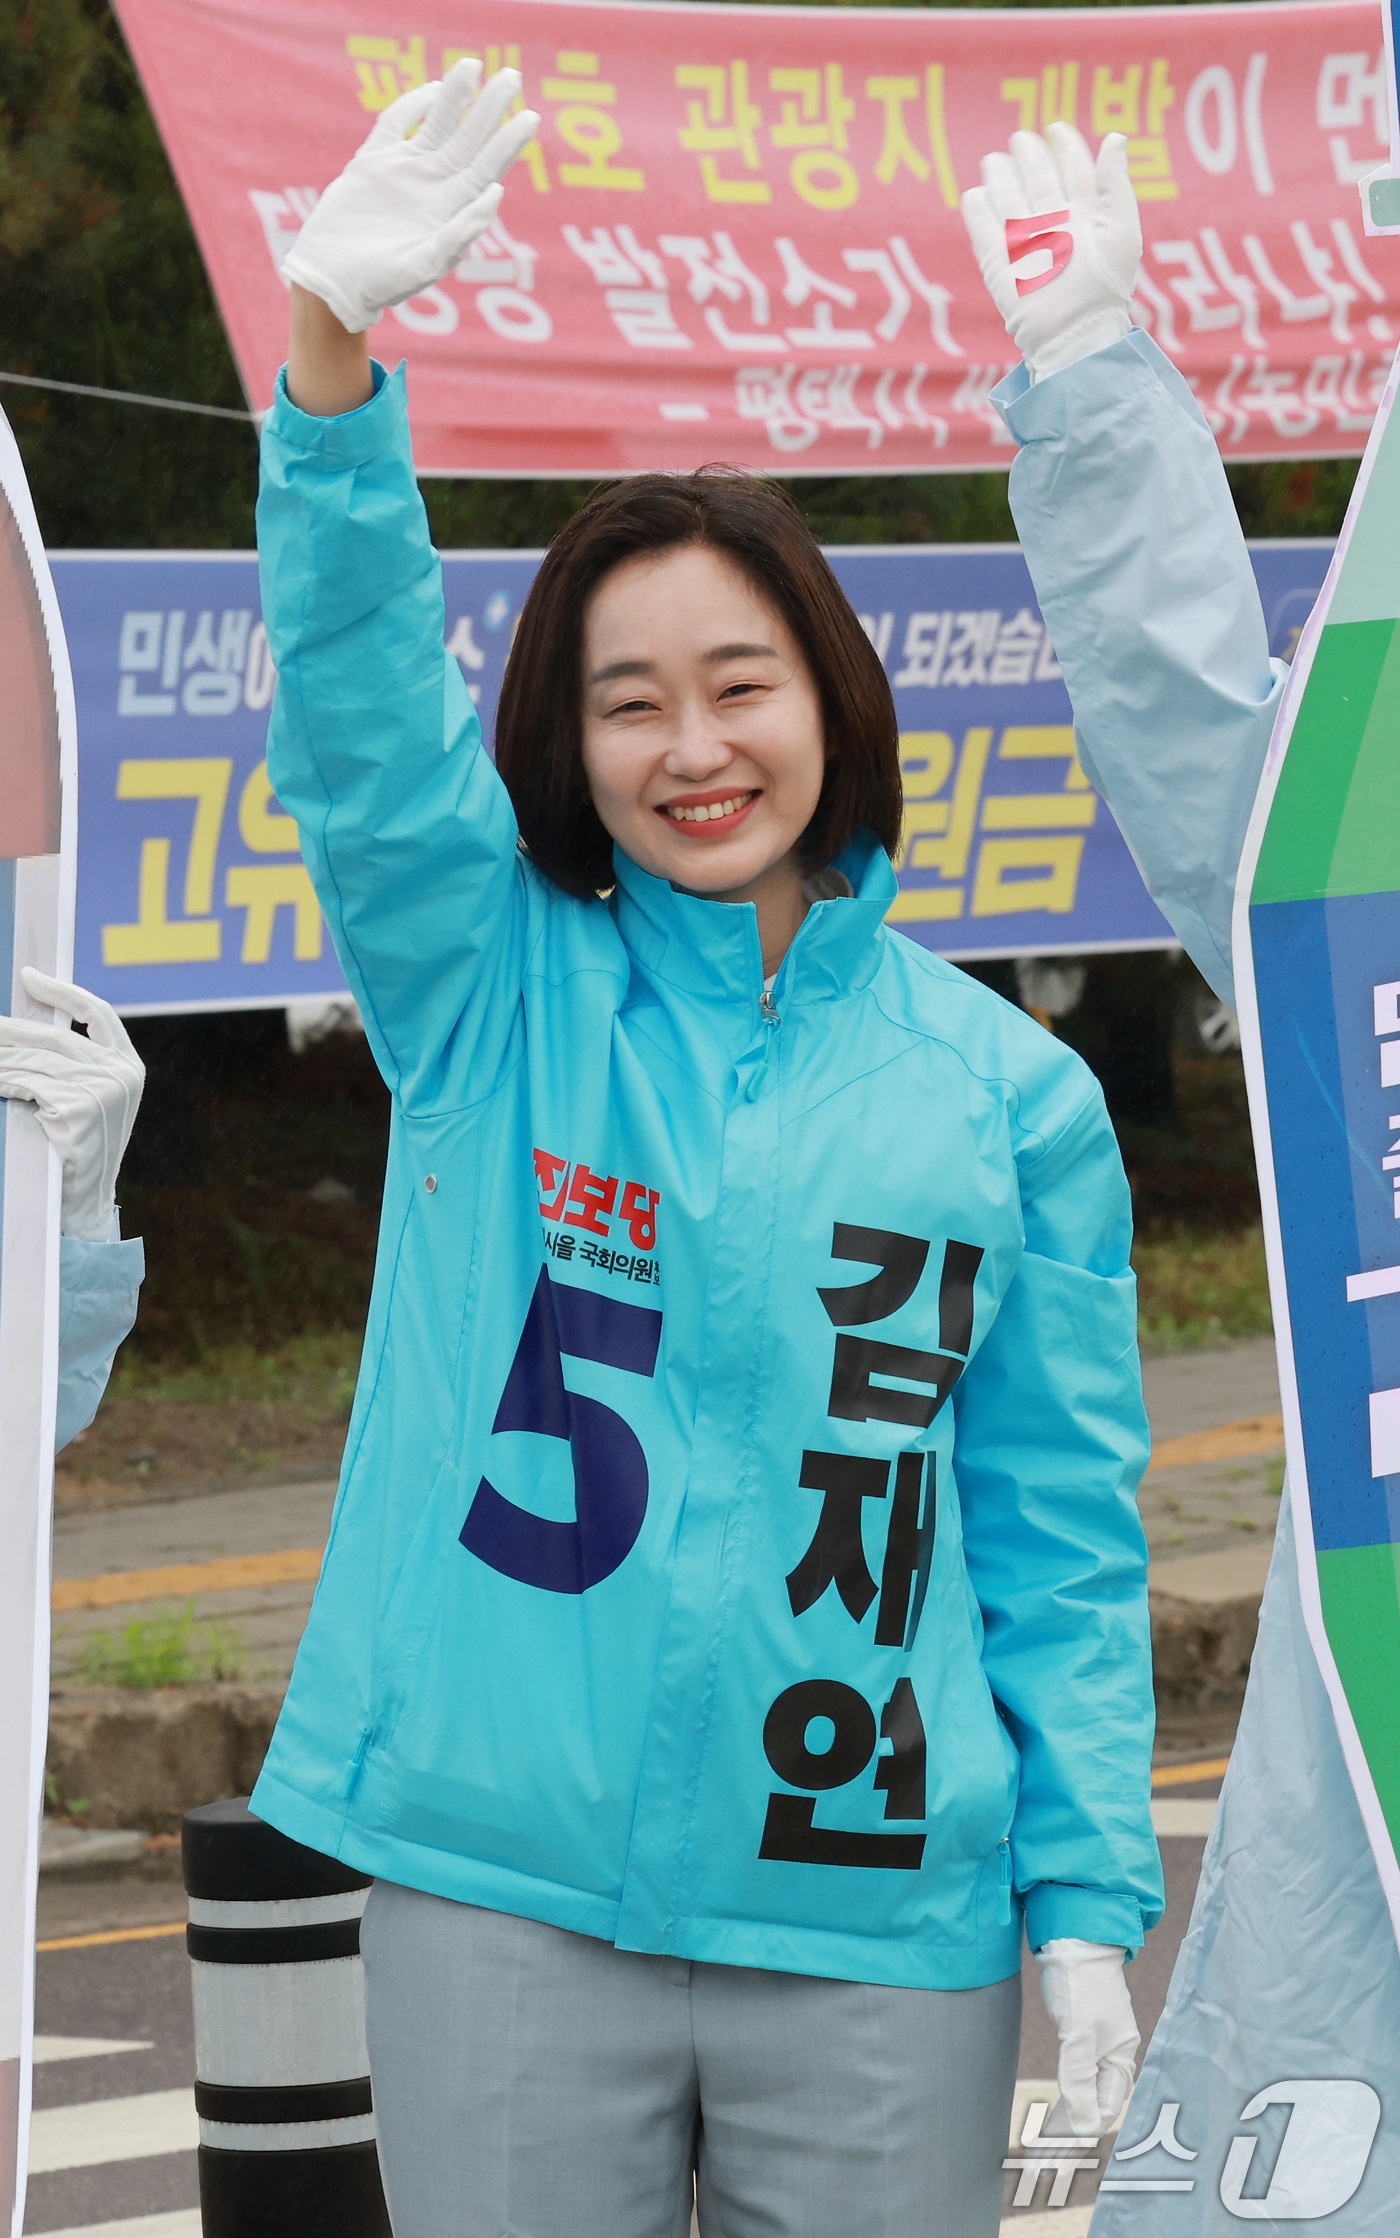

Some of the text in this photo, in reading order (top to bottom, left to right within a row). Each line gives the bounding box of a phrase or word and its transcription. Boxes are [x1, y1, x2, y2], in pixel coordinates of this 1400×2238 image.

[675, 58, 960, 209] 관광지
[561, 223, 966, 357] 발전소가
[1005, 209, 1074, 297] 5
[532, 1146, 661, 1251] 진보당
[542, 1227, 576, 1261] 시을
[579, 1240, 654, 1284] 국회의원
[458, 1261, 663, 1595] 5
[757, 1220, 986, 1871] 김재연
